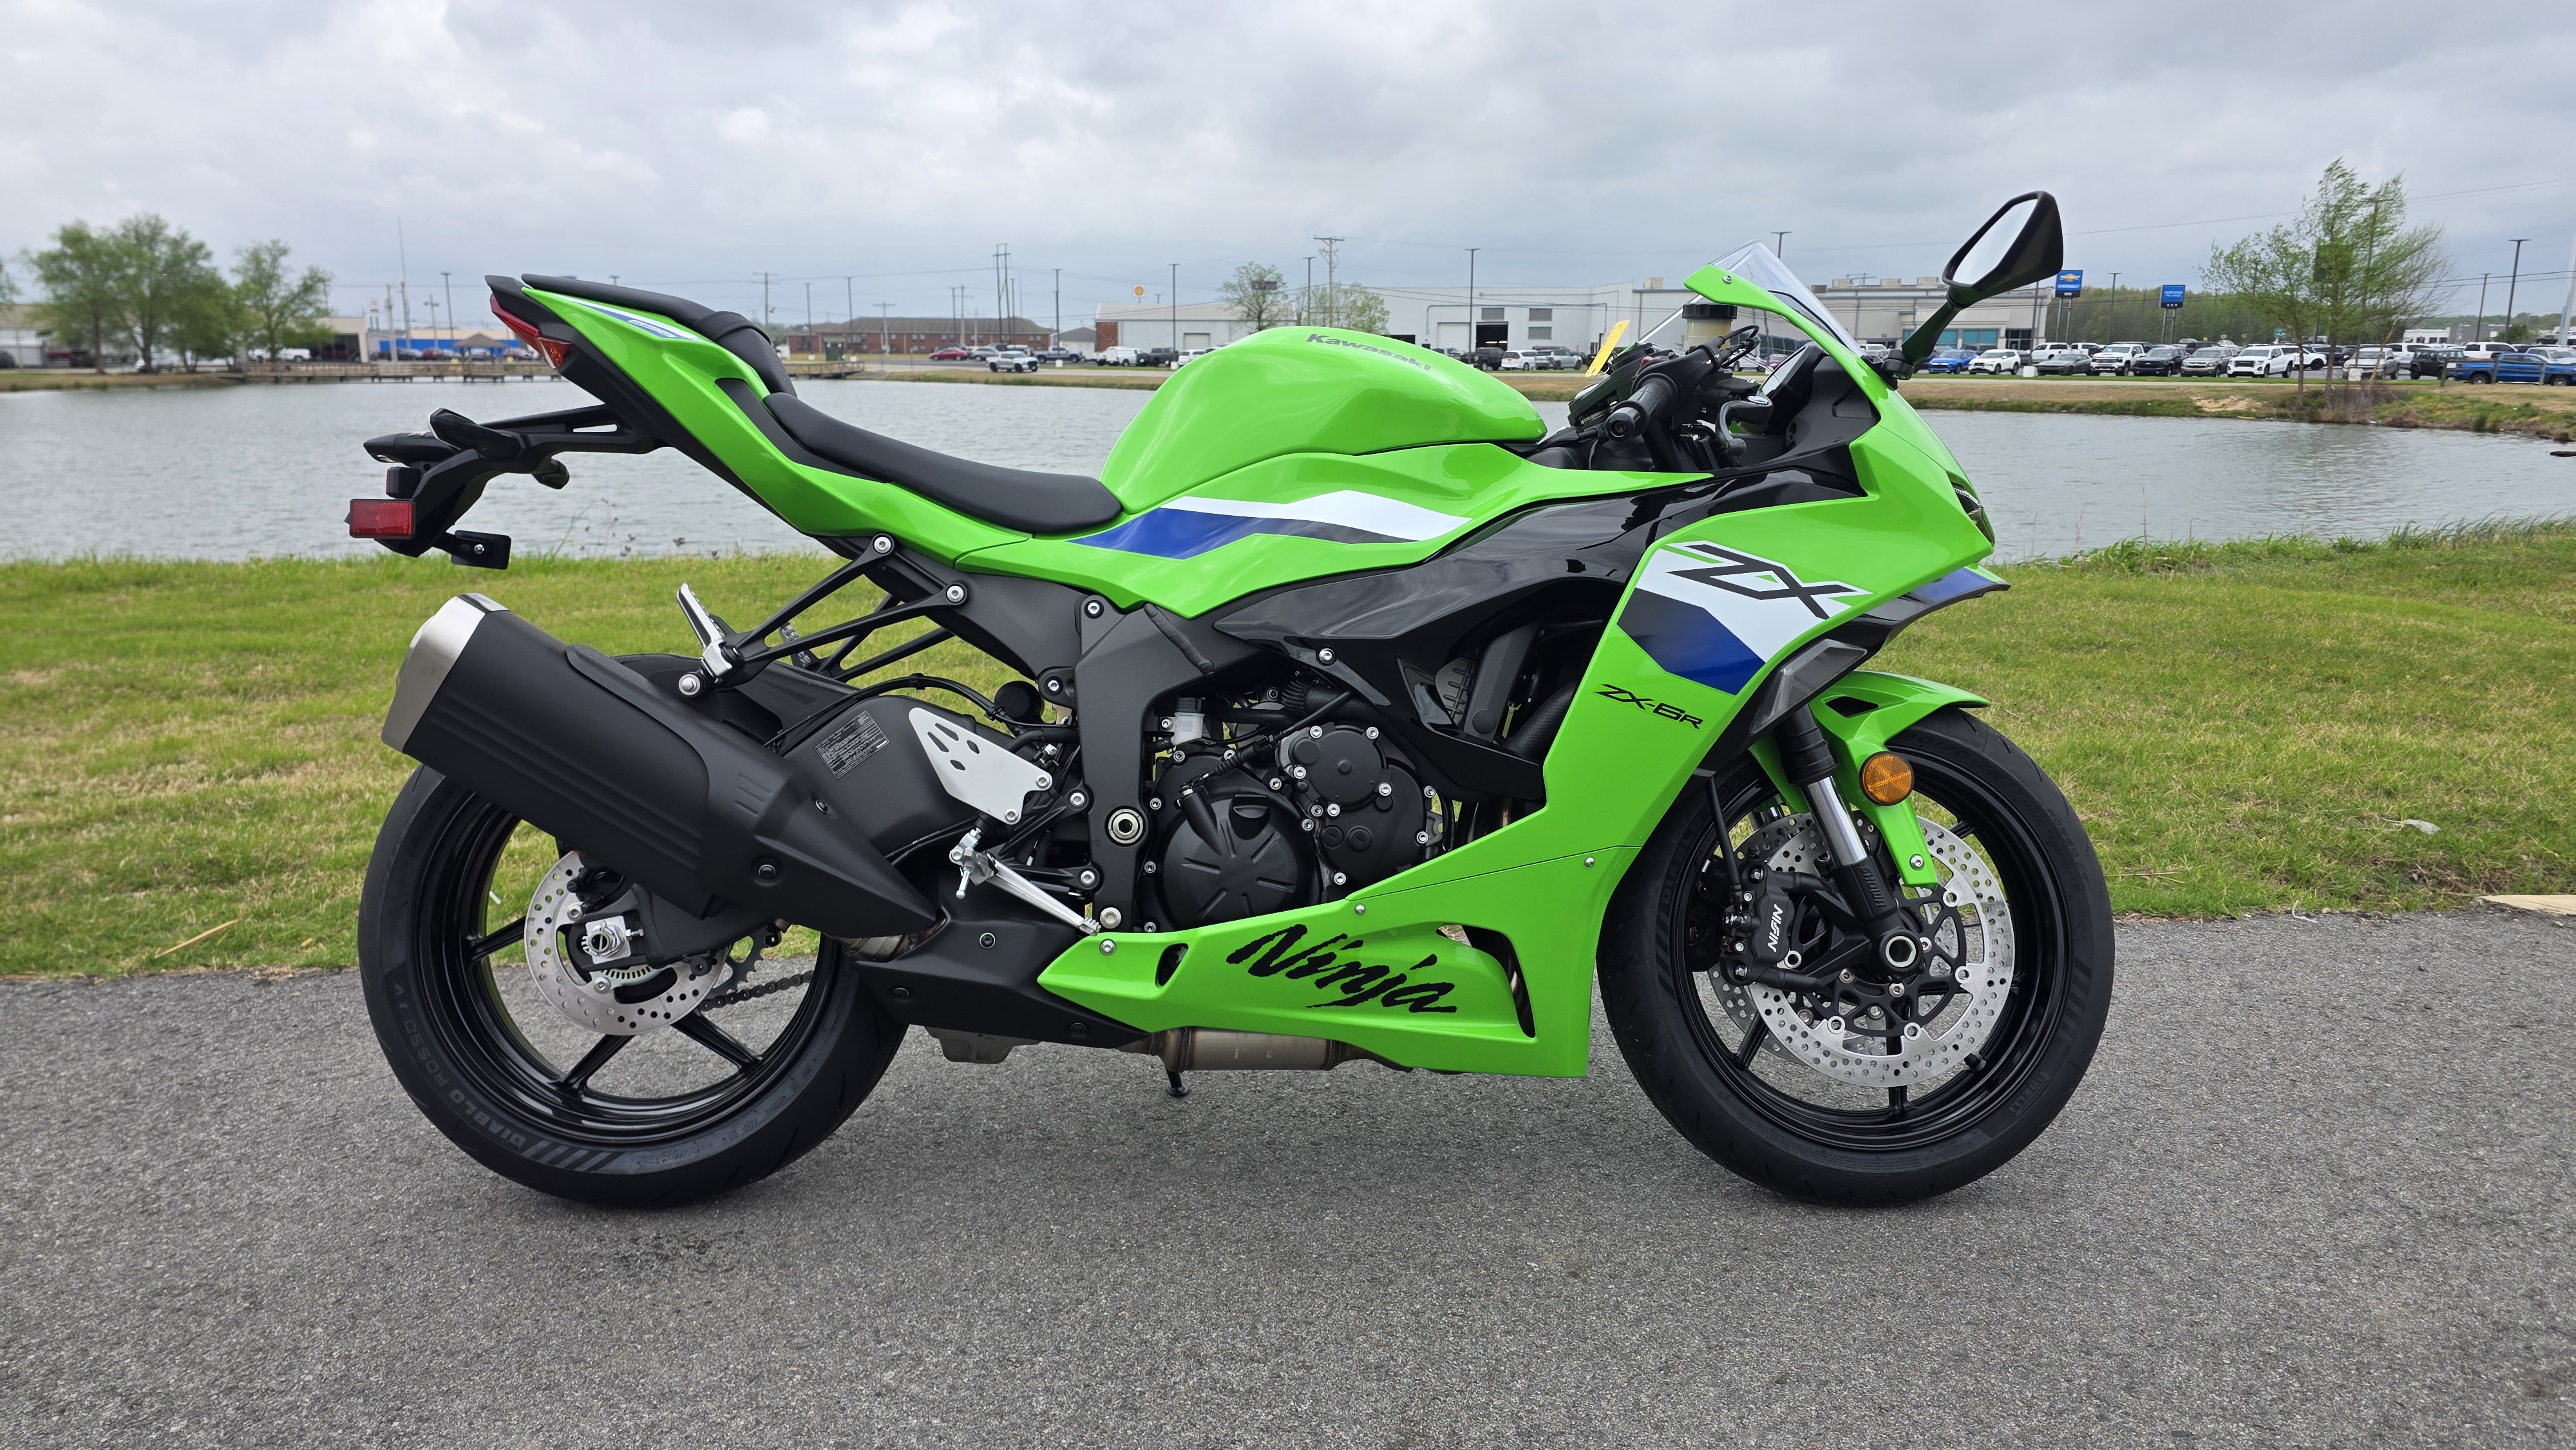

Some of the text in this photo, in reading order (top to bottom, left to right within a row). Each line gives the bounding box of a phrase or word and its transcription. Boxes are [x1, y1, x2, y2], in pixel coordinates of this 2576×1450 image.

[1306, 334, 1432, 371] Kawasaki
[1665, 544, 1857, 620] ZX
[1595, 684, 1703, 730] ZX-6R
[1860, 865, 1887, 907] SHOWA
[1768, 904, 1783, 952] NISSIN
[1226, 924, 1457, 1013] Ninja
[404, 1019, 450, 1086] ROSSO
[2009, 1070, 2052, 1117] PIRELLI
[449, 1089, 527, 1149] DIABLO
